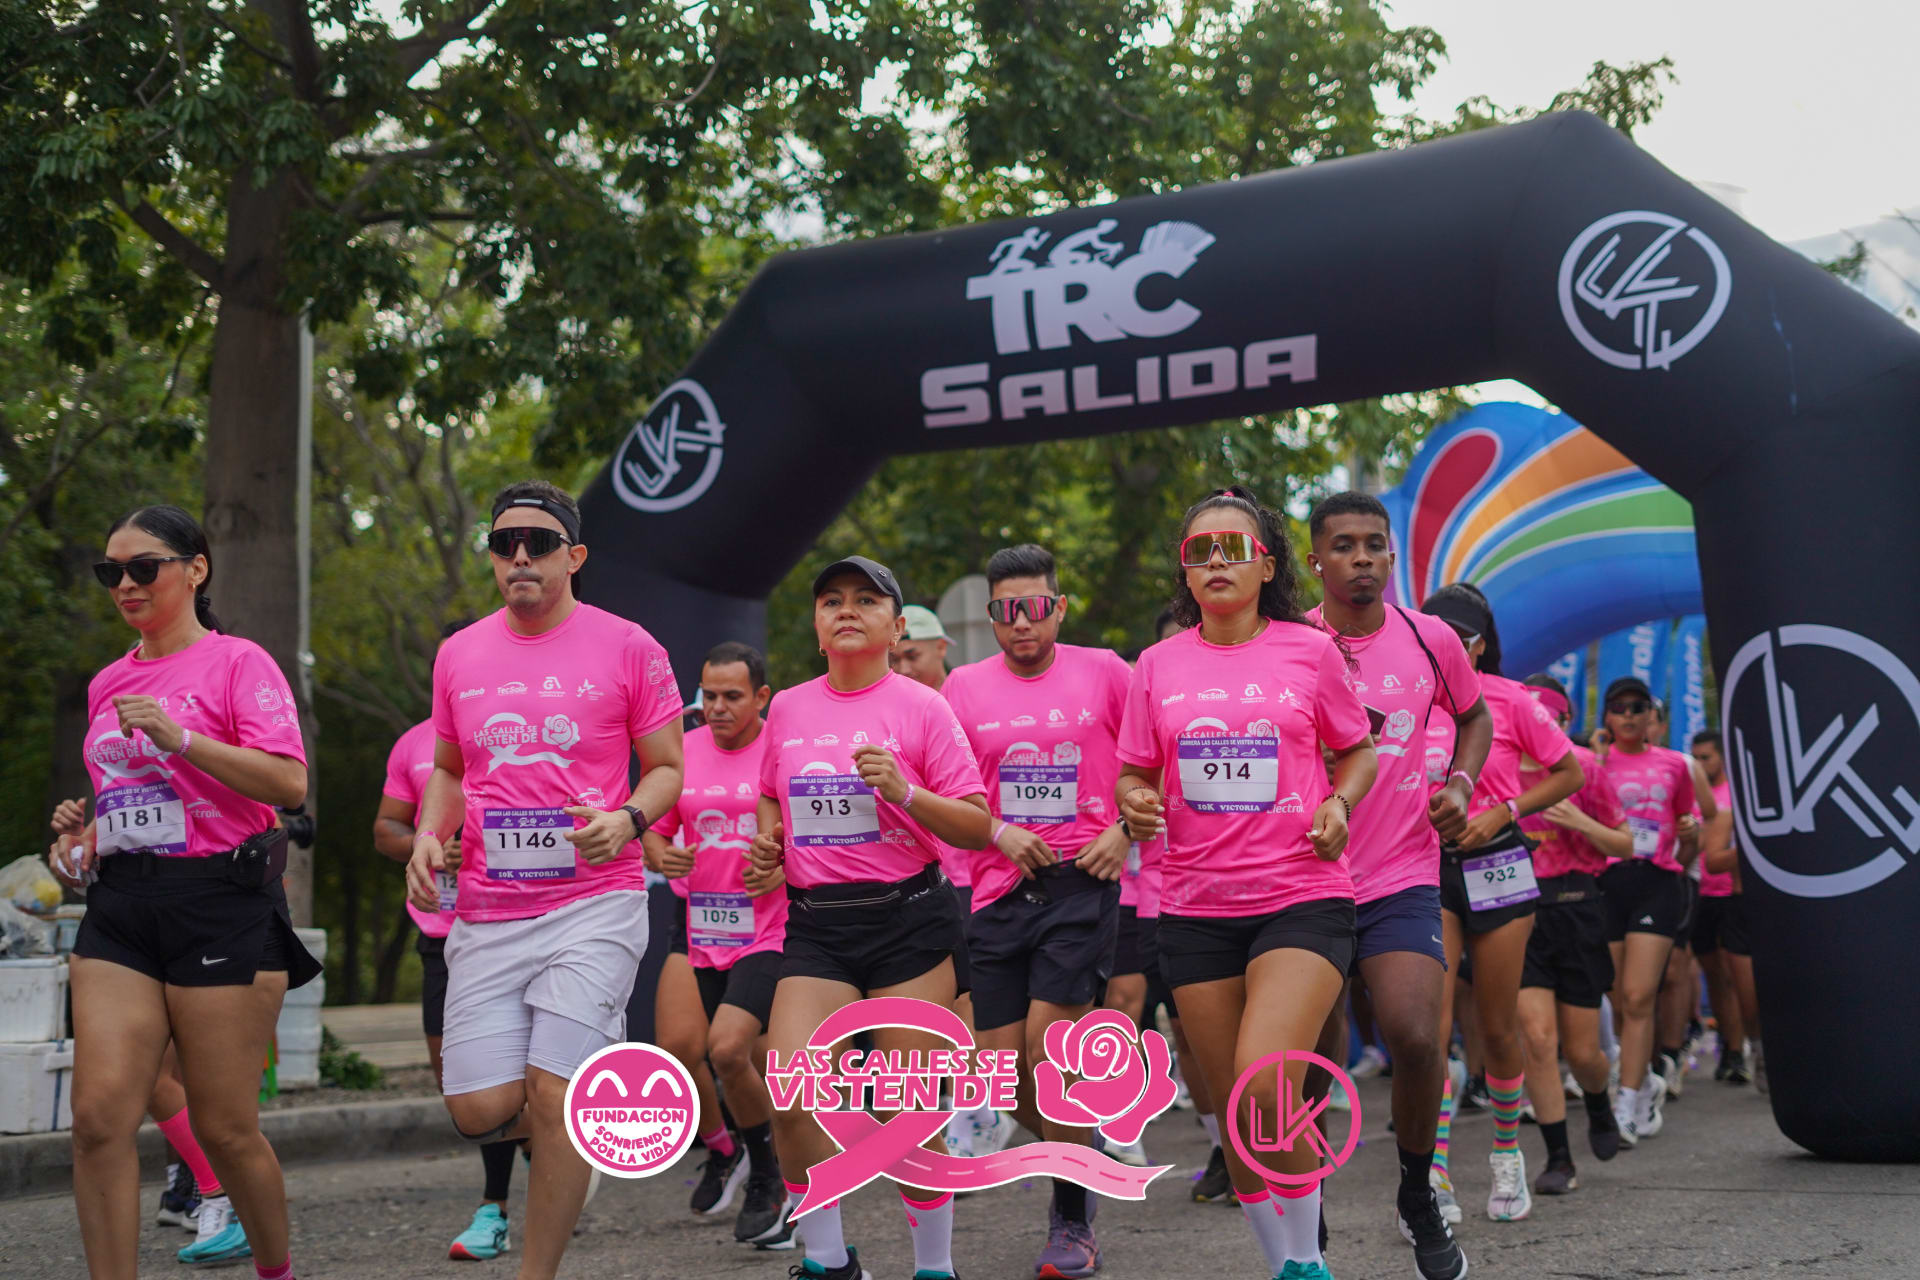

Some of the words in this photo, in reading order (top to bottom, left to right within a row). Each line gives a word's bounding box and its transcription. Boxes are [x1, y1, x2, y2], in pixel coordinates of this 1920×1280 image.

[966, 240, 1203, 355] TRC
[920, 334, 1318, 429] SALIDA
[473, 727, 489, 739] LAS
[490, 725, 525, 736] CALLES
[527, 725, 537, 733] SE
[474, 732, 518, 749] VISTEN
[521, 732, 538, 744] DE
[99, 740, 128, 753] CALLES
[87, 749, 127, 765] VISTEN
[127, 747, 140, 759] DE
[1203, 762, 1251, 780] 914
[1013, 785, 1063, 800] 1094
[810, 799, 851, 816] 913
[1198, 803, 1215, 811] 10K
[1220, 803, 1260, 812] VICTORIA
[107, 806, 162, 833] 1181
[498, 832, 557, 849] 1146
[808, 836, 825, 845] 10K
[828, 835, 865, 845] VICTORIA
[498, 871, 514, 879] 10K
[519, 870, 560, 879] VICTORIA
[1484, 866, 1517, 884] 932
[702, 909, 740, 924] 1075
